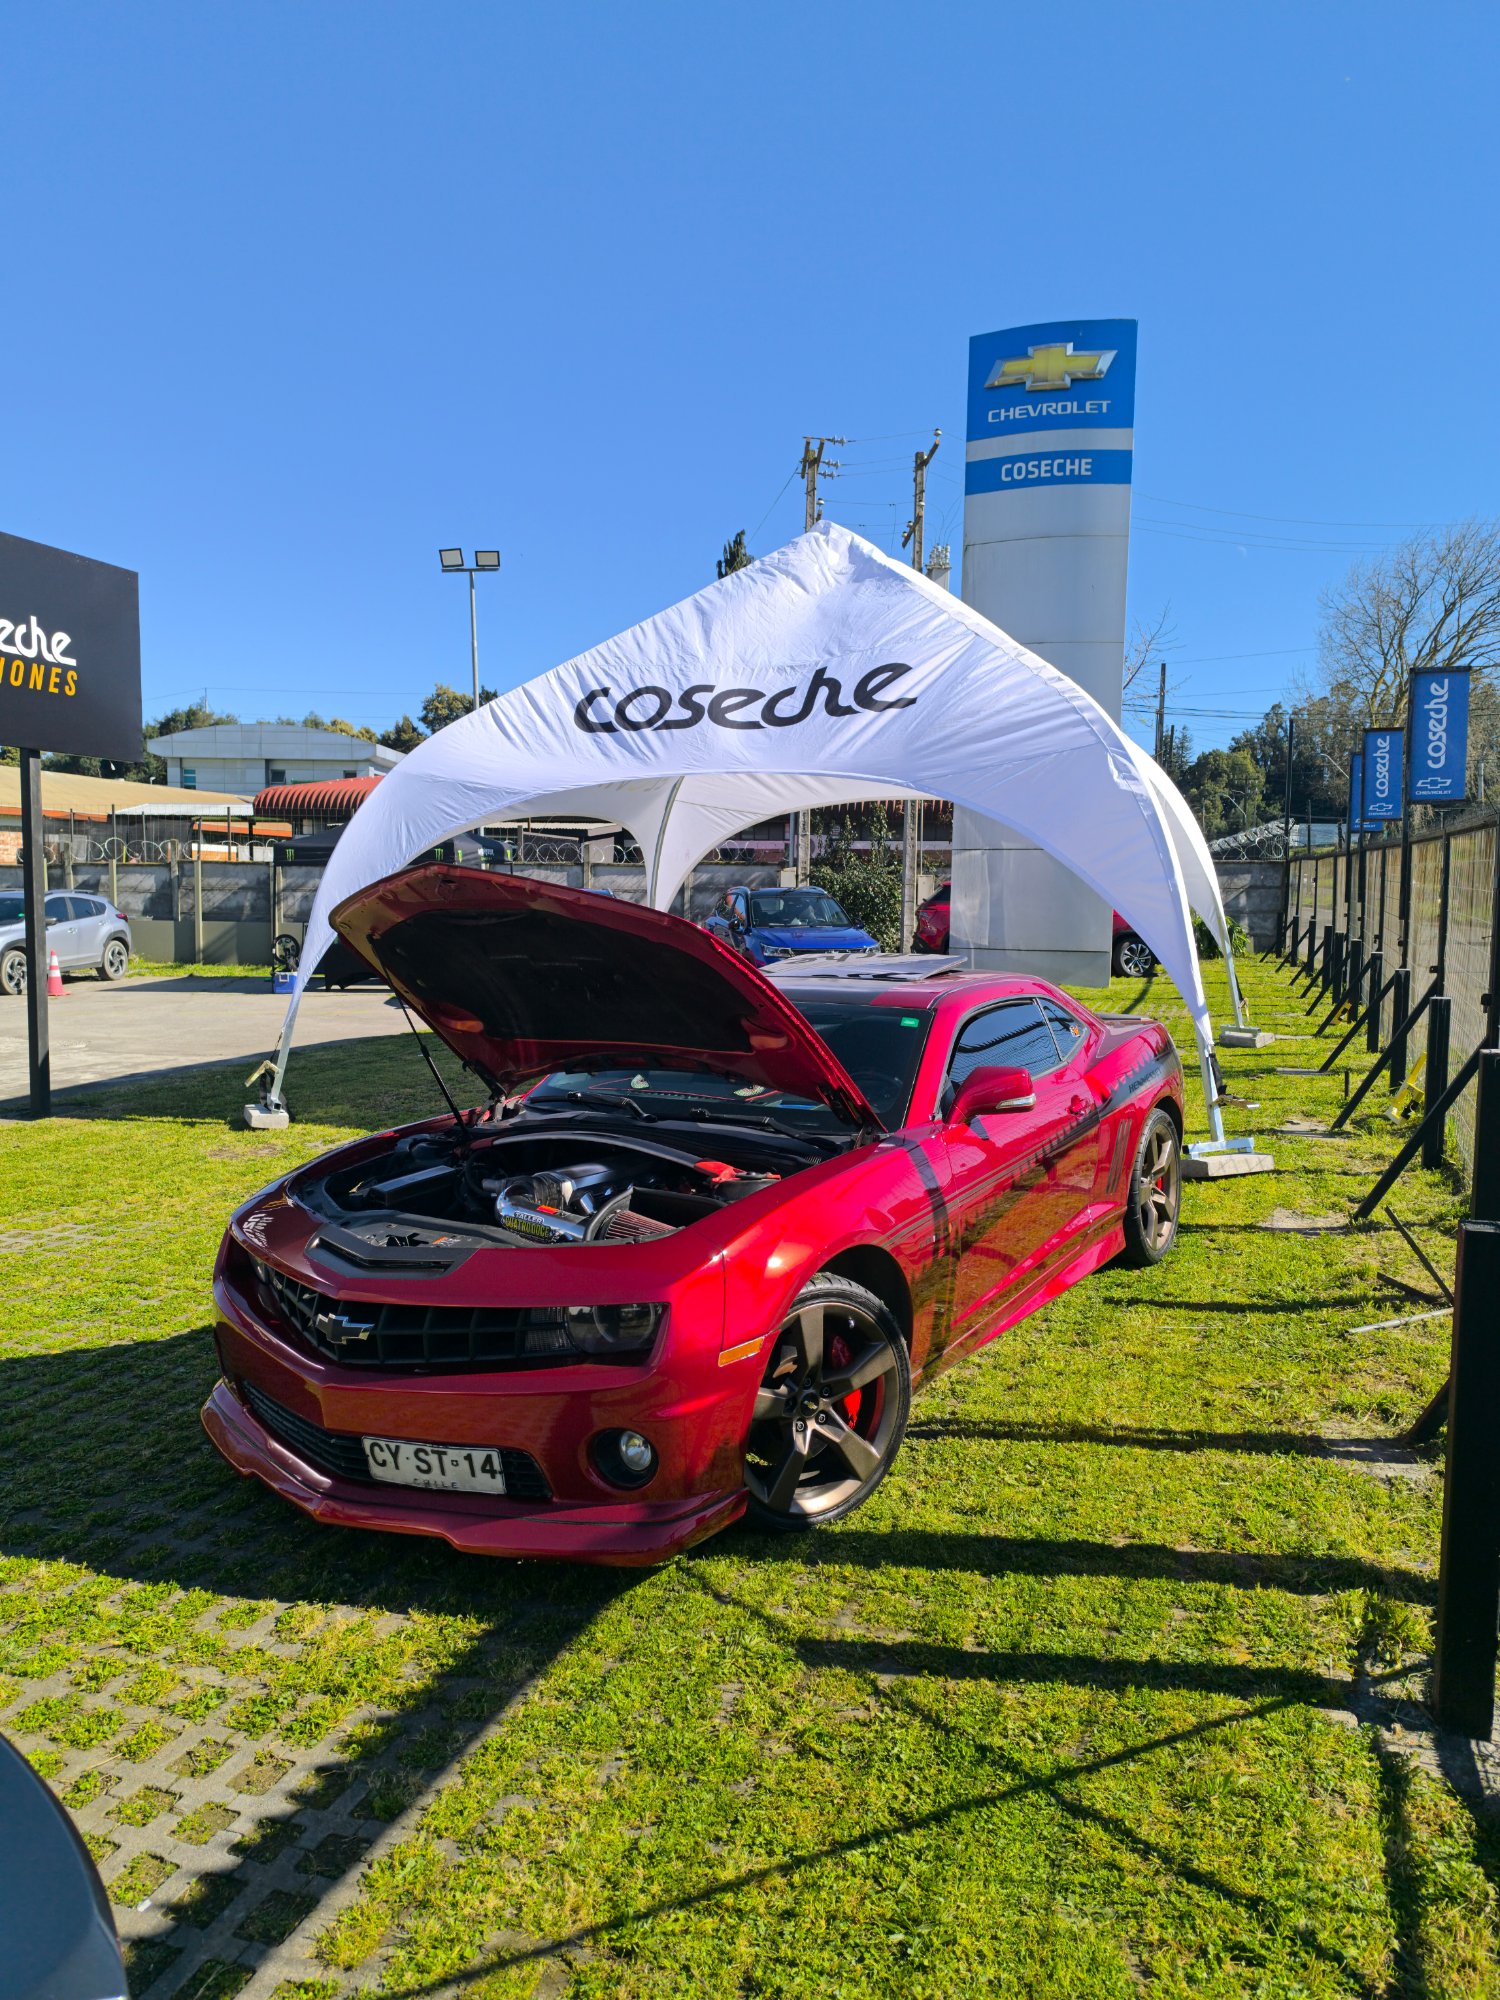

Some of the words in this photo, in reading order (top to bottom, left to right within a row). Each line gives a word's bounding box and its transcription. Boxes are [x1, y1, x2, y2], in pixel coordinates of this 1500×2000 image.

[987, 400, 1111, 423] CHEVROLET
[1001, 458, 1093, 482] COSECHE
[573, 662, 918, 733] coseche
[1424, 678, 1449, 769] coseche
[1373, 735, 1390, 798] coseche
[515, 1212, 543, 1223] TALLER
